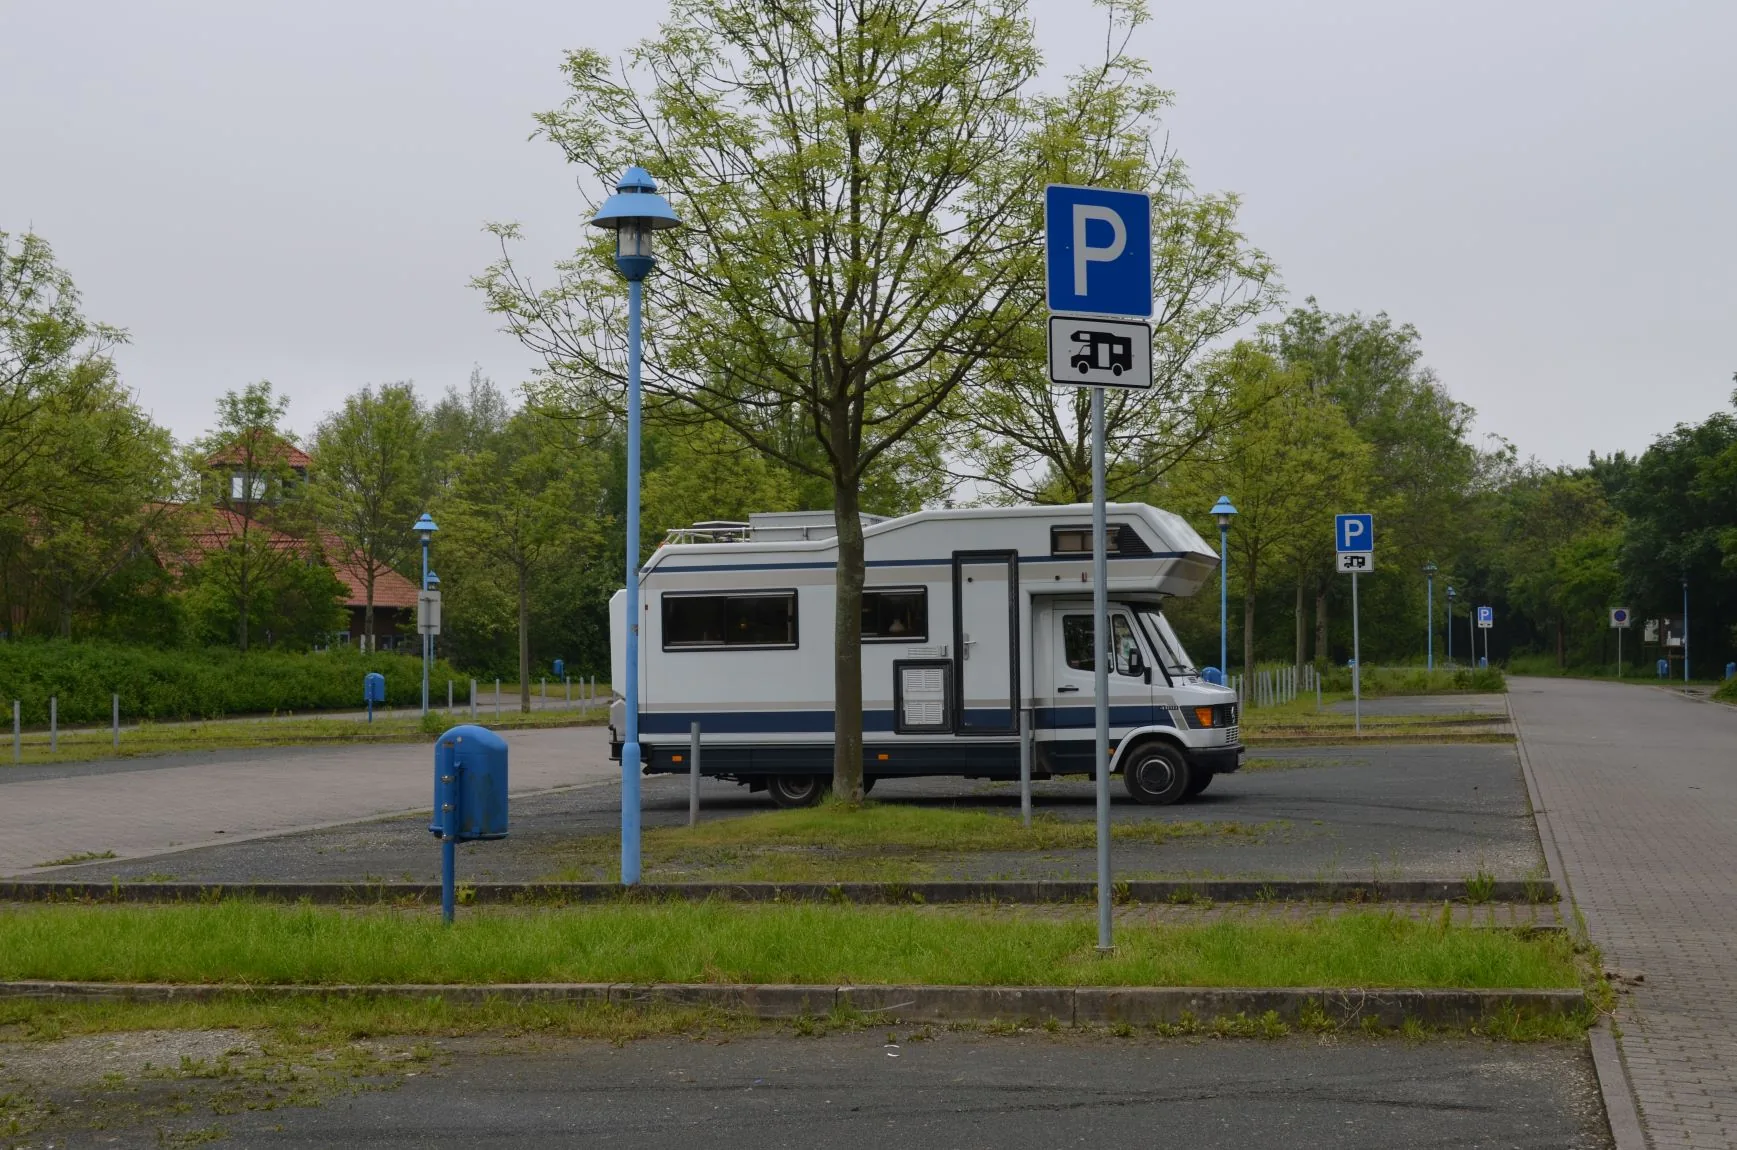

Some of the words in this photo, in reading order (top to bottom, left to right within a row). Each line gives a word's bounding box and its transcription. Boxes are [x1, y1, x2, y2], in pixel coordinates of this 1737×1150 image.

[1072, 203, 1127, 296] P
[1344, 519, 1364, 547] P
[1480, 609, 1489, 621] P
